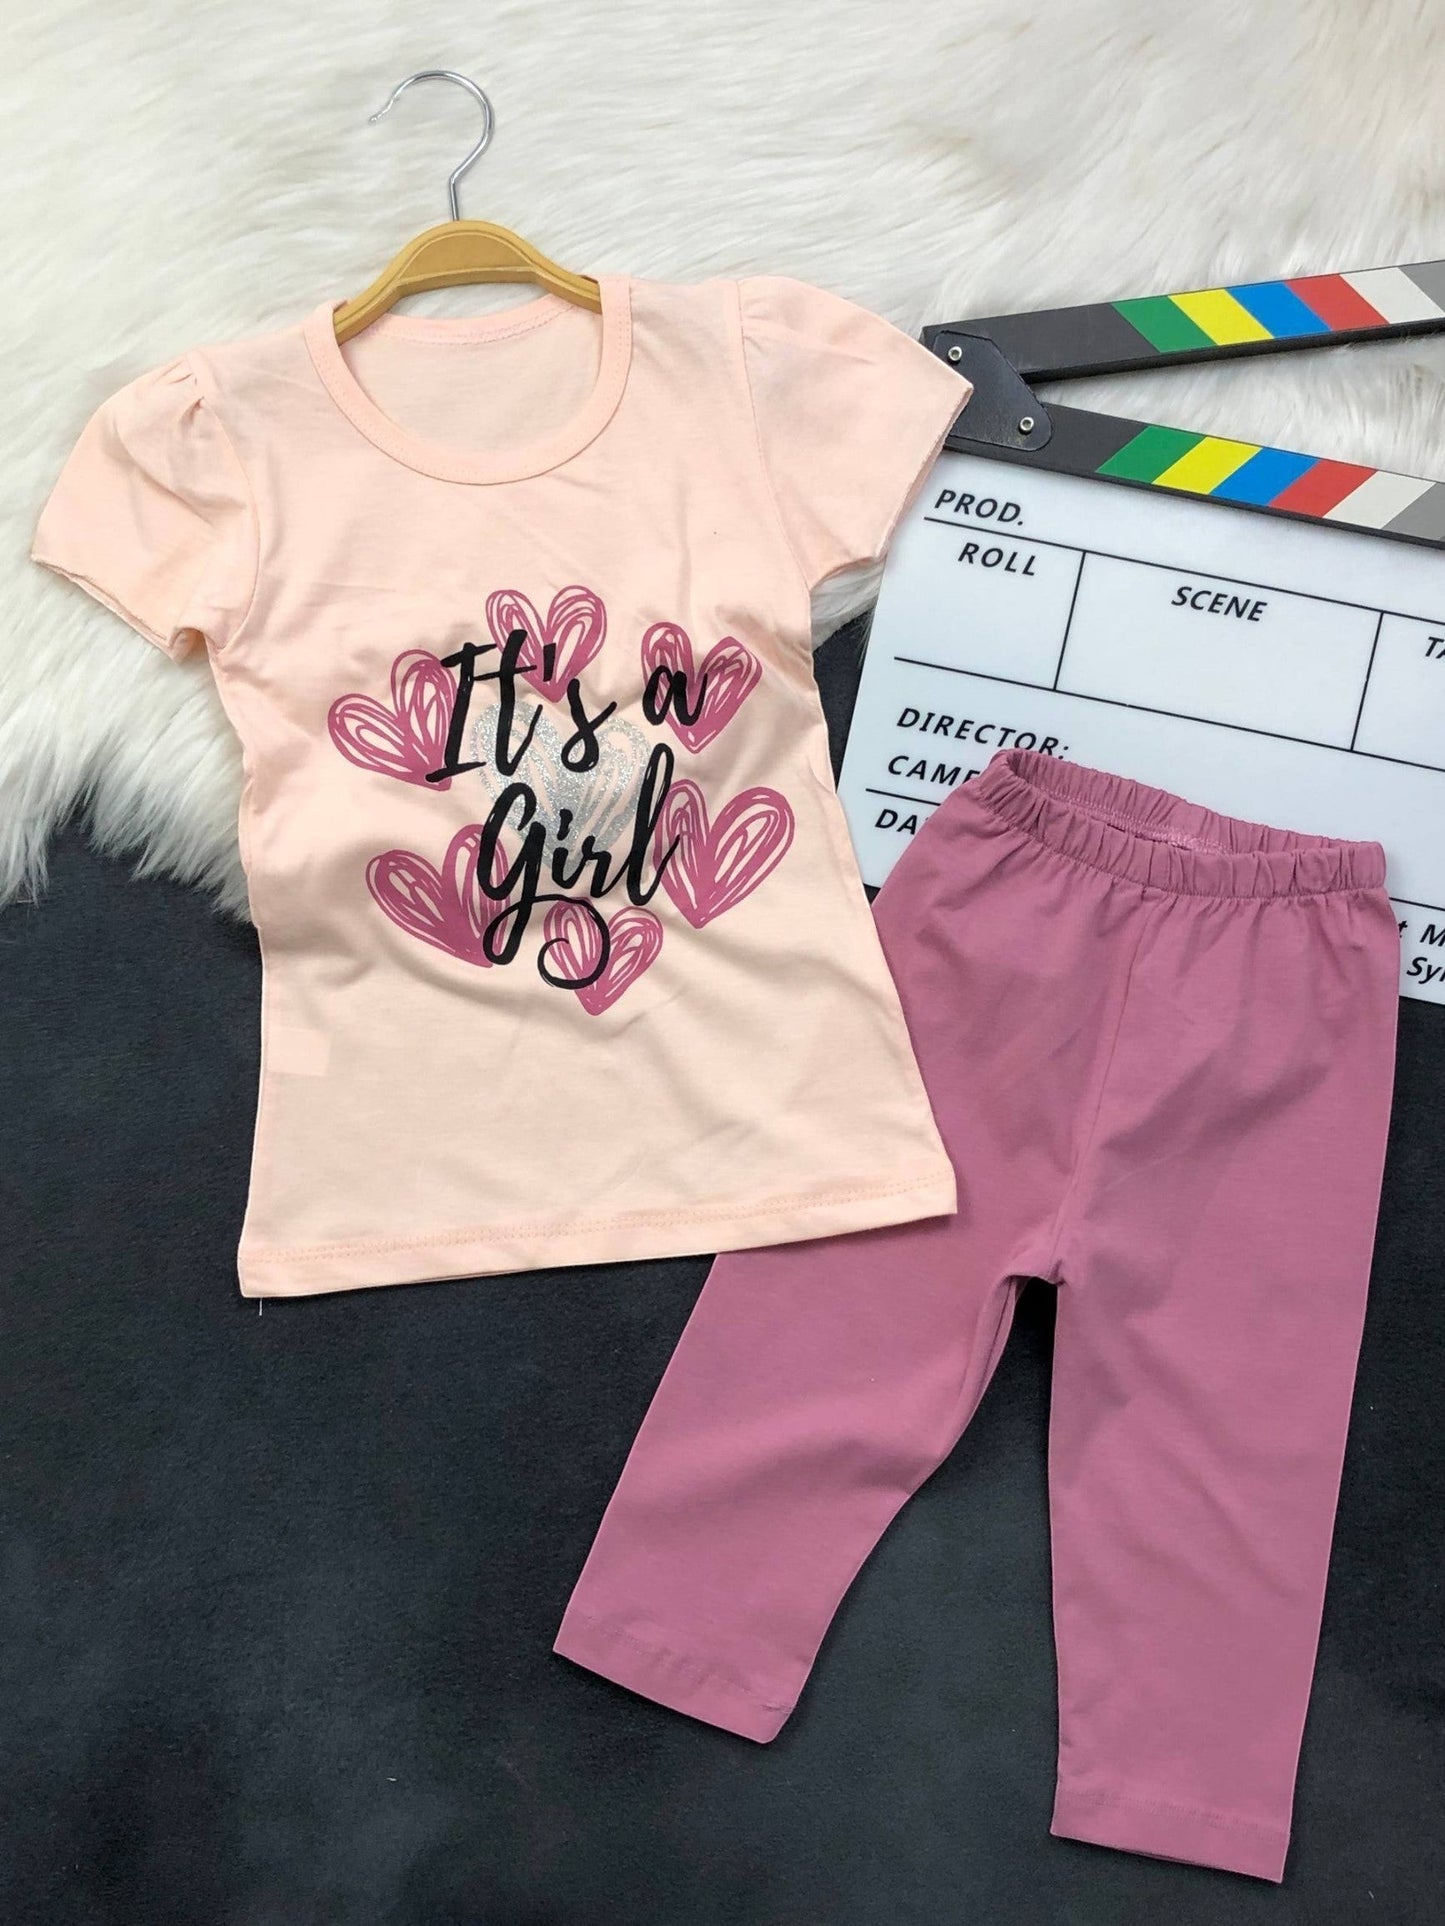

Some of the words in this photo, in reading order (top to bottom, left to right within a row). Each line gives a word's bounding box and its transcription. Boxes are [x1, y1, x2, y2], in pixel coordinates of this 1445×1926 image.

[934, 488, 1024, 527] PROD.
[957, 542, 1036, 577] ROLL
[1171, 586, 1268, 622] SCENE
[425, 629, 617, 783] It's
[642, 664, 708, 727] a
[896, 707, 1069, 759] DIRECTOR:
[874, 808, 929, 836] DA
[476, 742, 681, 990] Girl
[1406, 956, 1445, 985] Sy
